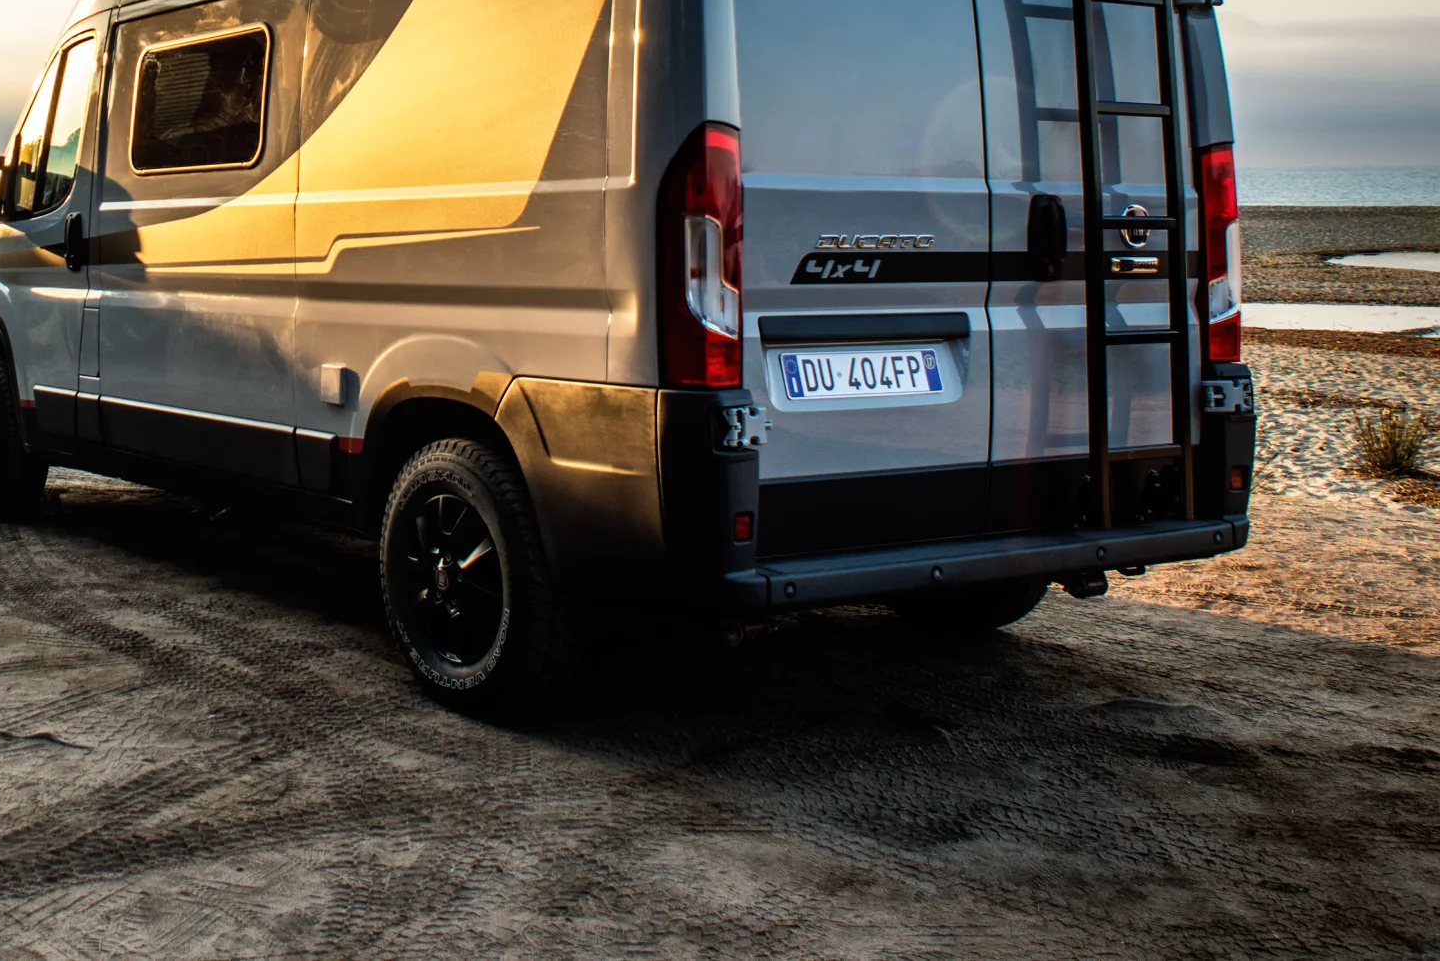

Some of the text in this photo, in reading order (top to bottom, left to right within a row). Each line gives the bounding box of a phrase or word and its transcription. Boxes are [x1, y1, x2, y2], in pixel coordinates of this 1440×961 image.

[815, 234, 935, 249] DUCATO
[805, 259, 881, 279] 4x4
[801, 355, 920, 392] DU 404FP
[409, 647, 485, 689] VENTURE
